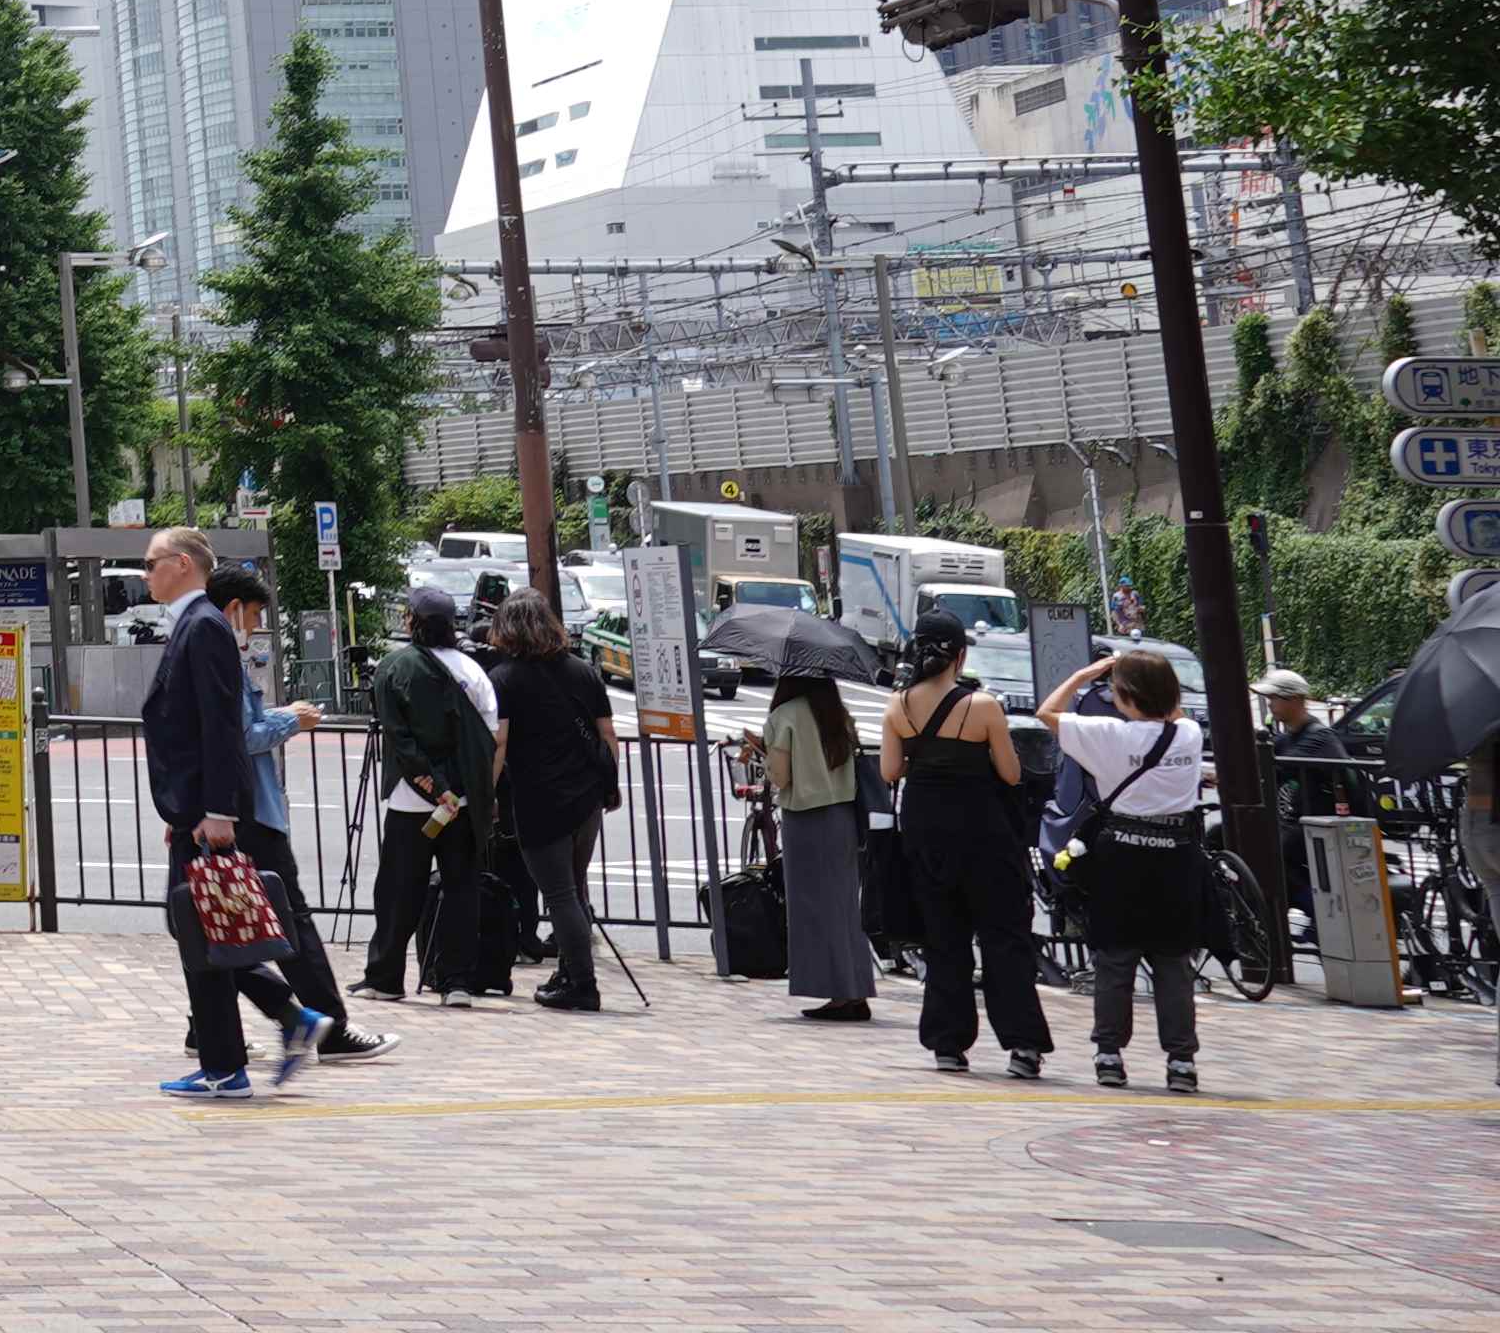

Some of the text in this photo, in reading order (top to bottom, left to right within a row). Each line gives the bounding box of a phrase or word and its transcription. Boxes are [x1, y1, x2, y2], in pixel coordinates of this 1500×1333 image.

[318, 506, 336, 534] P
[1128, 753, 1193, 767] Nzen
[1113, 830, 1177, 849] TAEYONG
